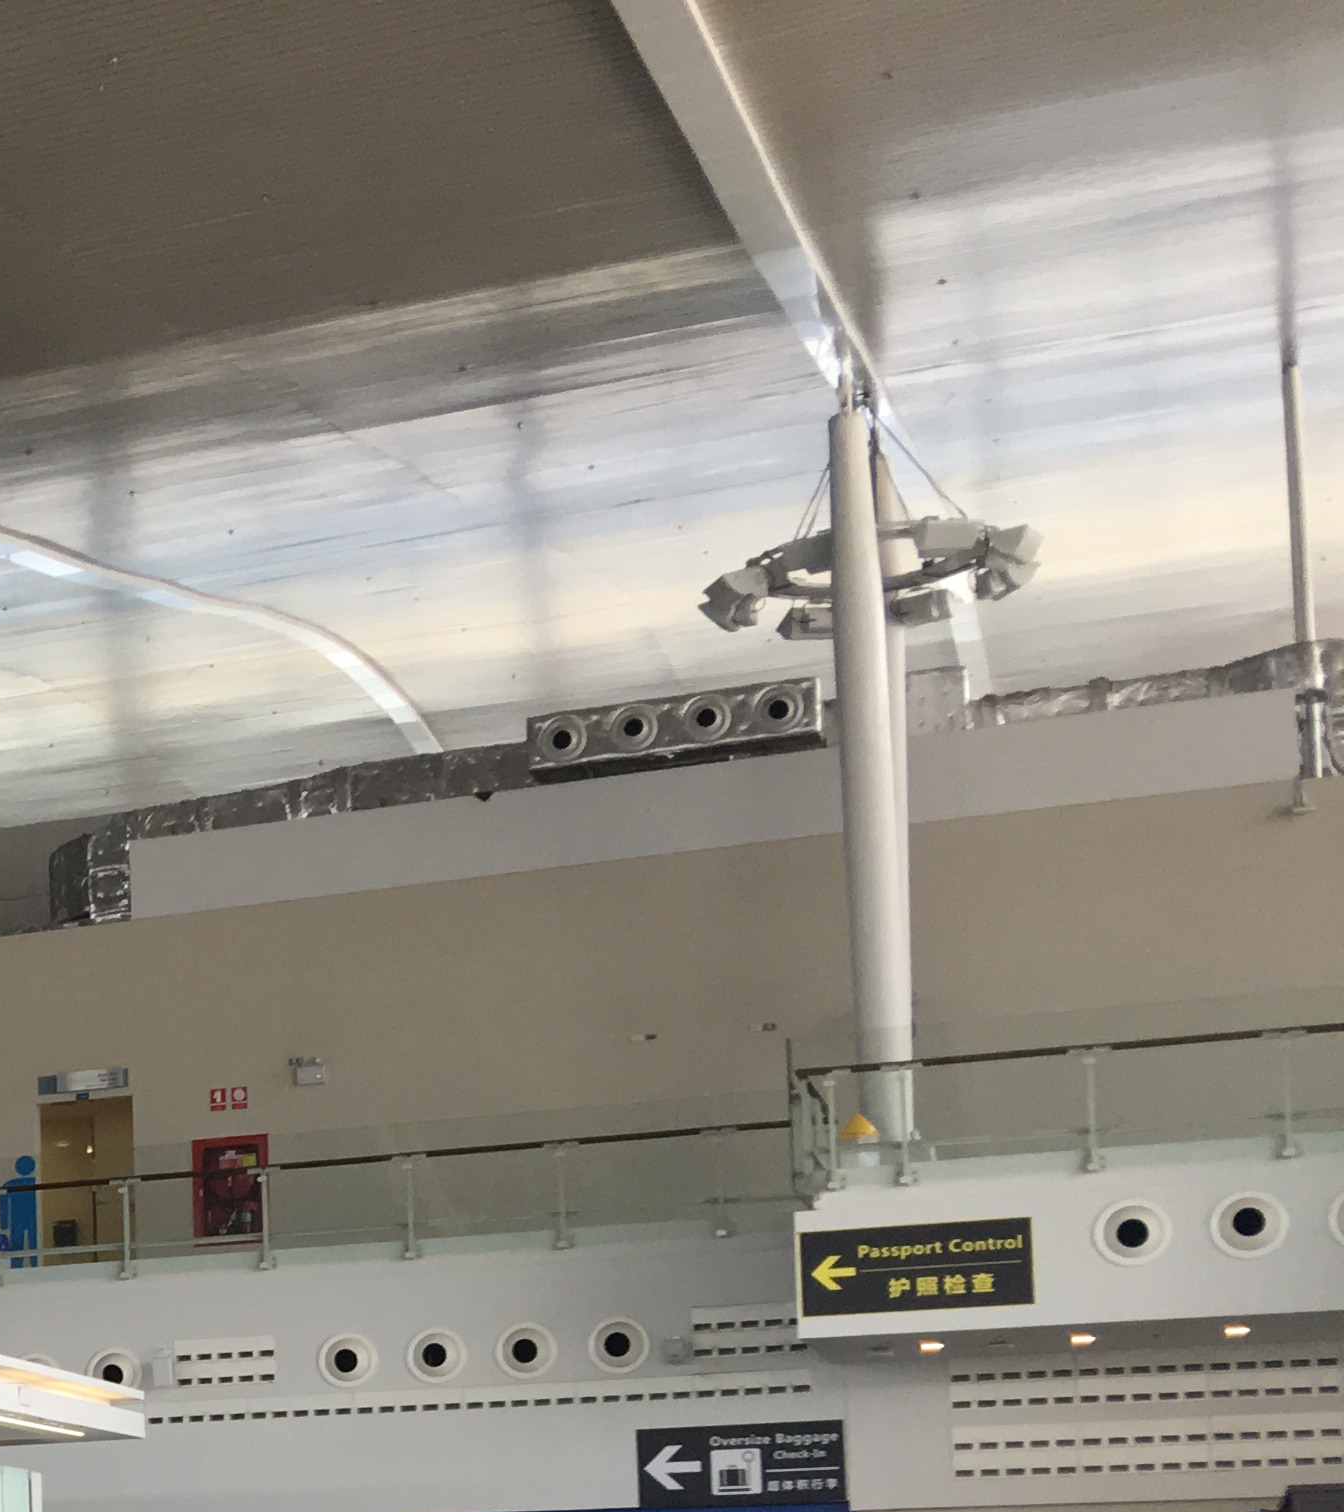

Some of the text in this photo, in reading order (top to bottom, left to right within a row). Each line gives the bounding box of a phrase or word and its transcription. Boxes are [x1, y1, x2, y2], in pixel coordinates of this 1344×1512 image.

[857, 1235, 1023, 1260] Passport Control
[888, 1273, 994, 1298] 护照检查
[775, 1433, 839, 1446] Baggage
